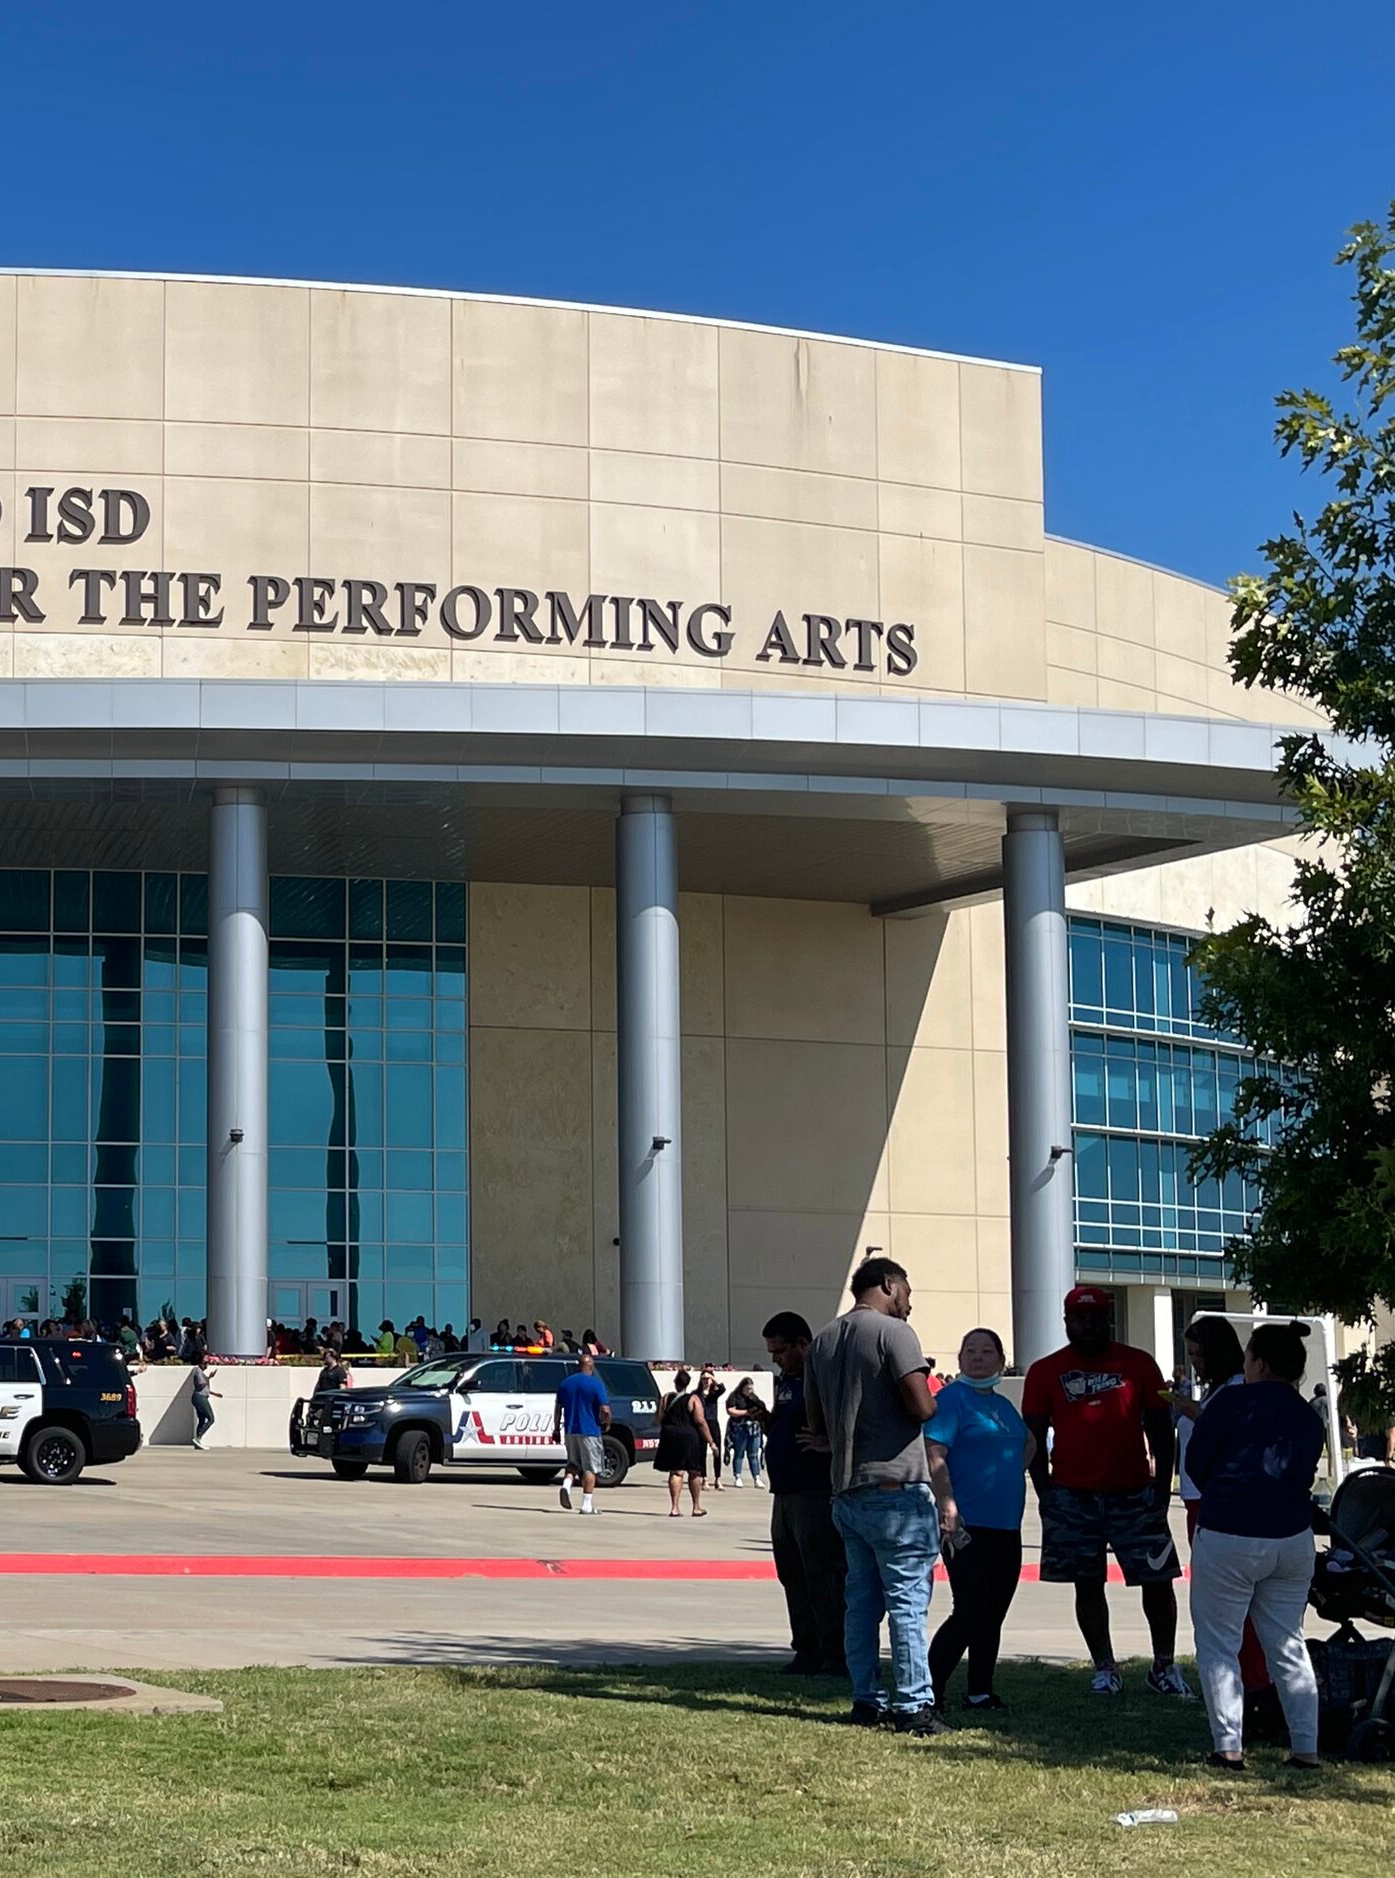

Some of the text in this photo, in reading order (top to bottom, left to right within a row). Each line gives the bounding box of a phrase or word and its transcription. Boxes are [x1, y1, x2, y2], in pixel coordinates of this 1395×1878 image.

[24, 487, 151, 545] ISD
[69, 570, 225, 629] THE
[246, 574, 737, 658] PERFORMING
[755, 610, 919, 677] ARTS
[500, 1412, 557, 1432] POLI
